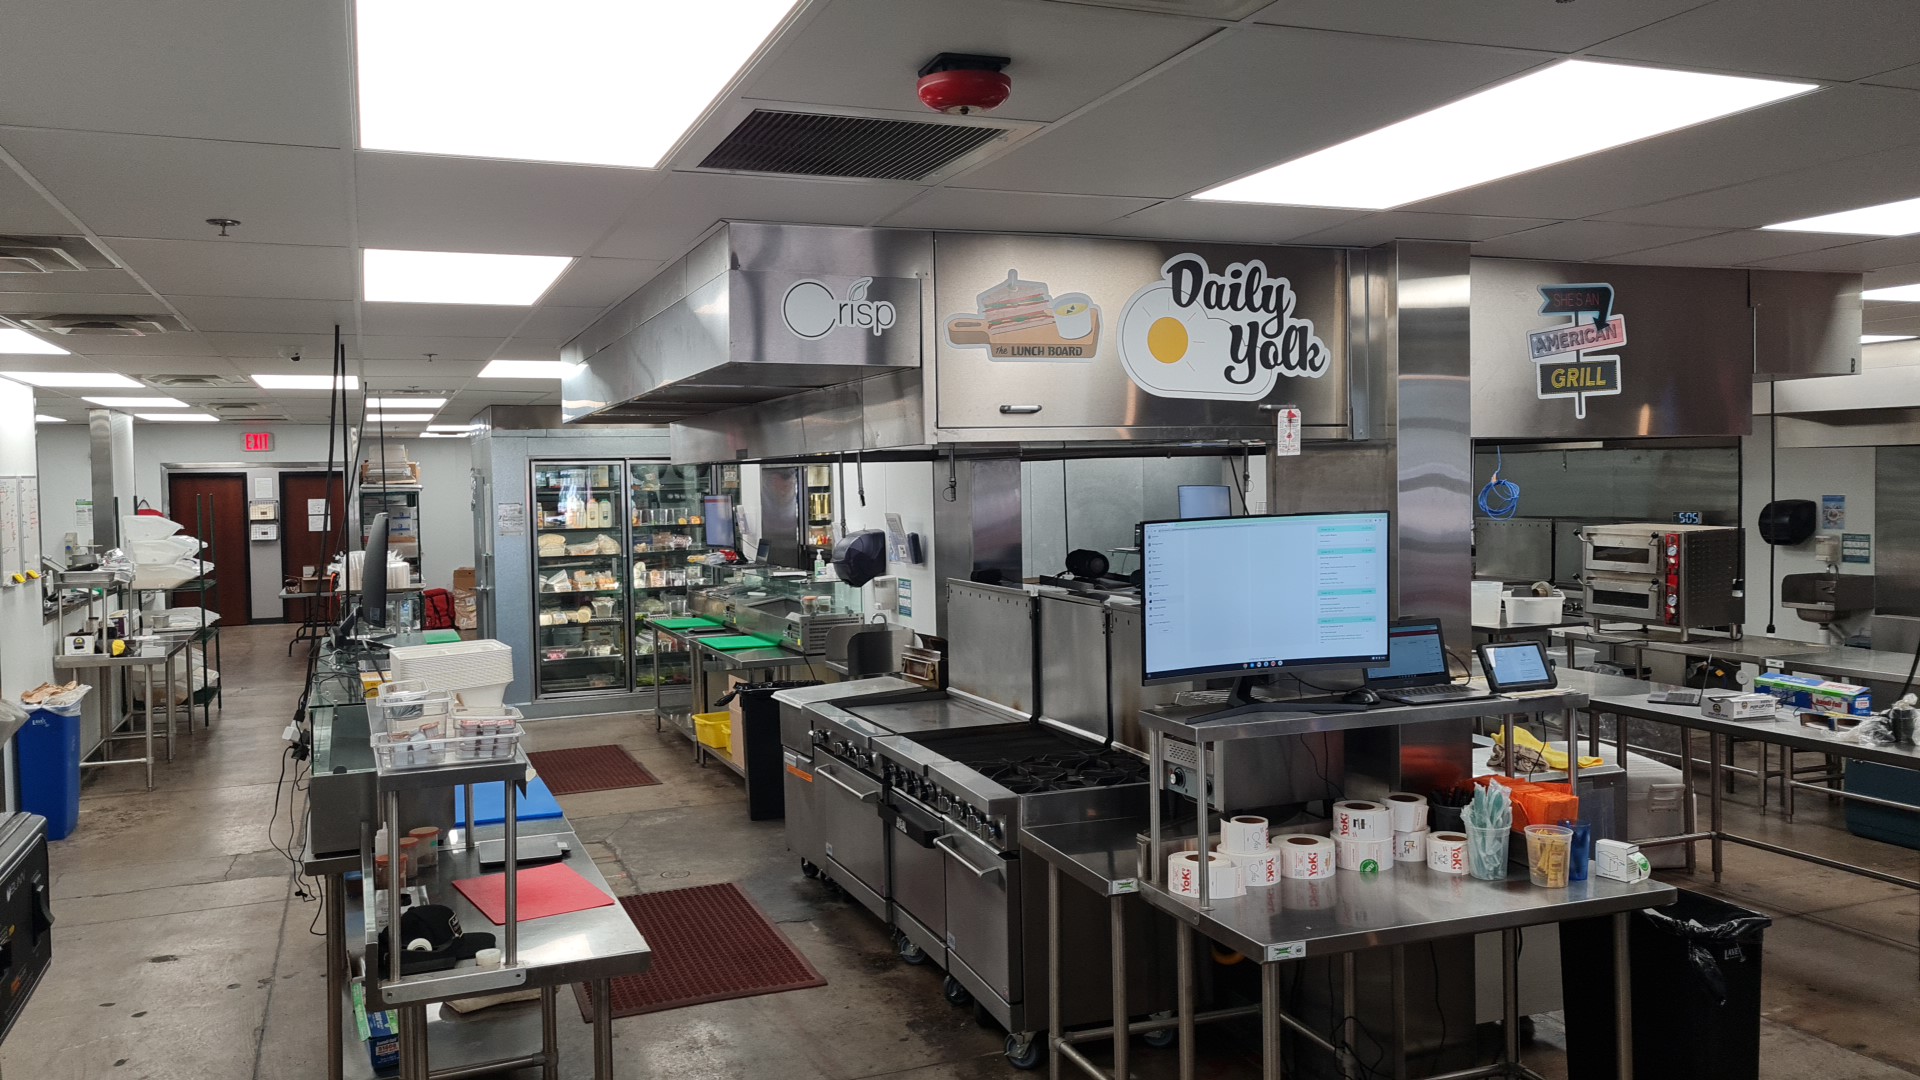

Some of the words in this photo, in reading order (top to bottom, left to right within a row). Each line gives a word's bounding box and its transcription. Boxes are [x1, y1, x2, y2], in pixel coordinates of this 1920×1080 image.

[783, 280, 894, 337] Crisp
[1167, 259, 1291, 339] Daily
[1585, 292, 1600, 305] AN
[1011, 345, 1045, 356] LUNCH
[1047, 345, 1083, 357] BOARD
[1536, 323, 1618, 354] AMERICAN
[1224, 321, 1326, 385] Yolk
[1551, 366, 1607, 389] GRILL
[245, 433, 270, 451] EXIT
